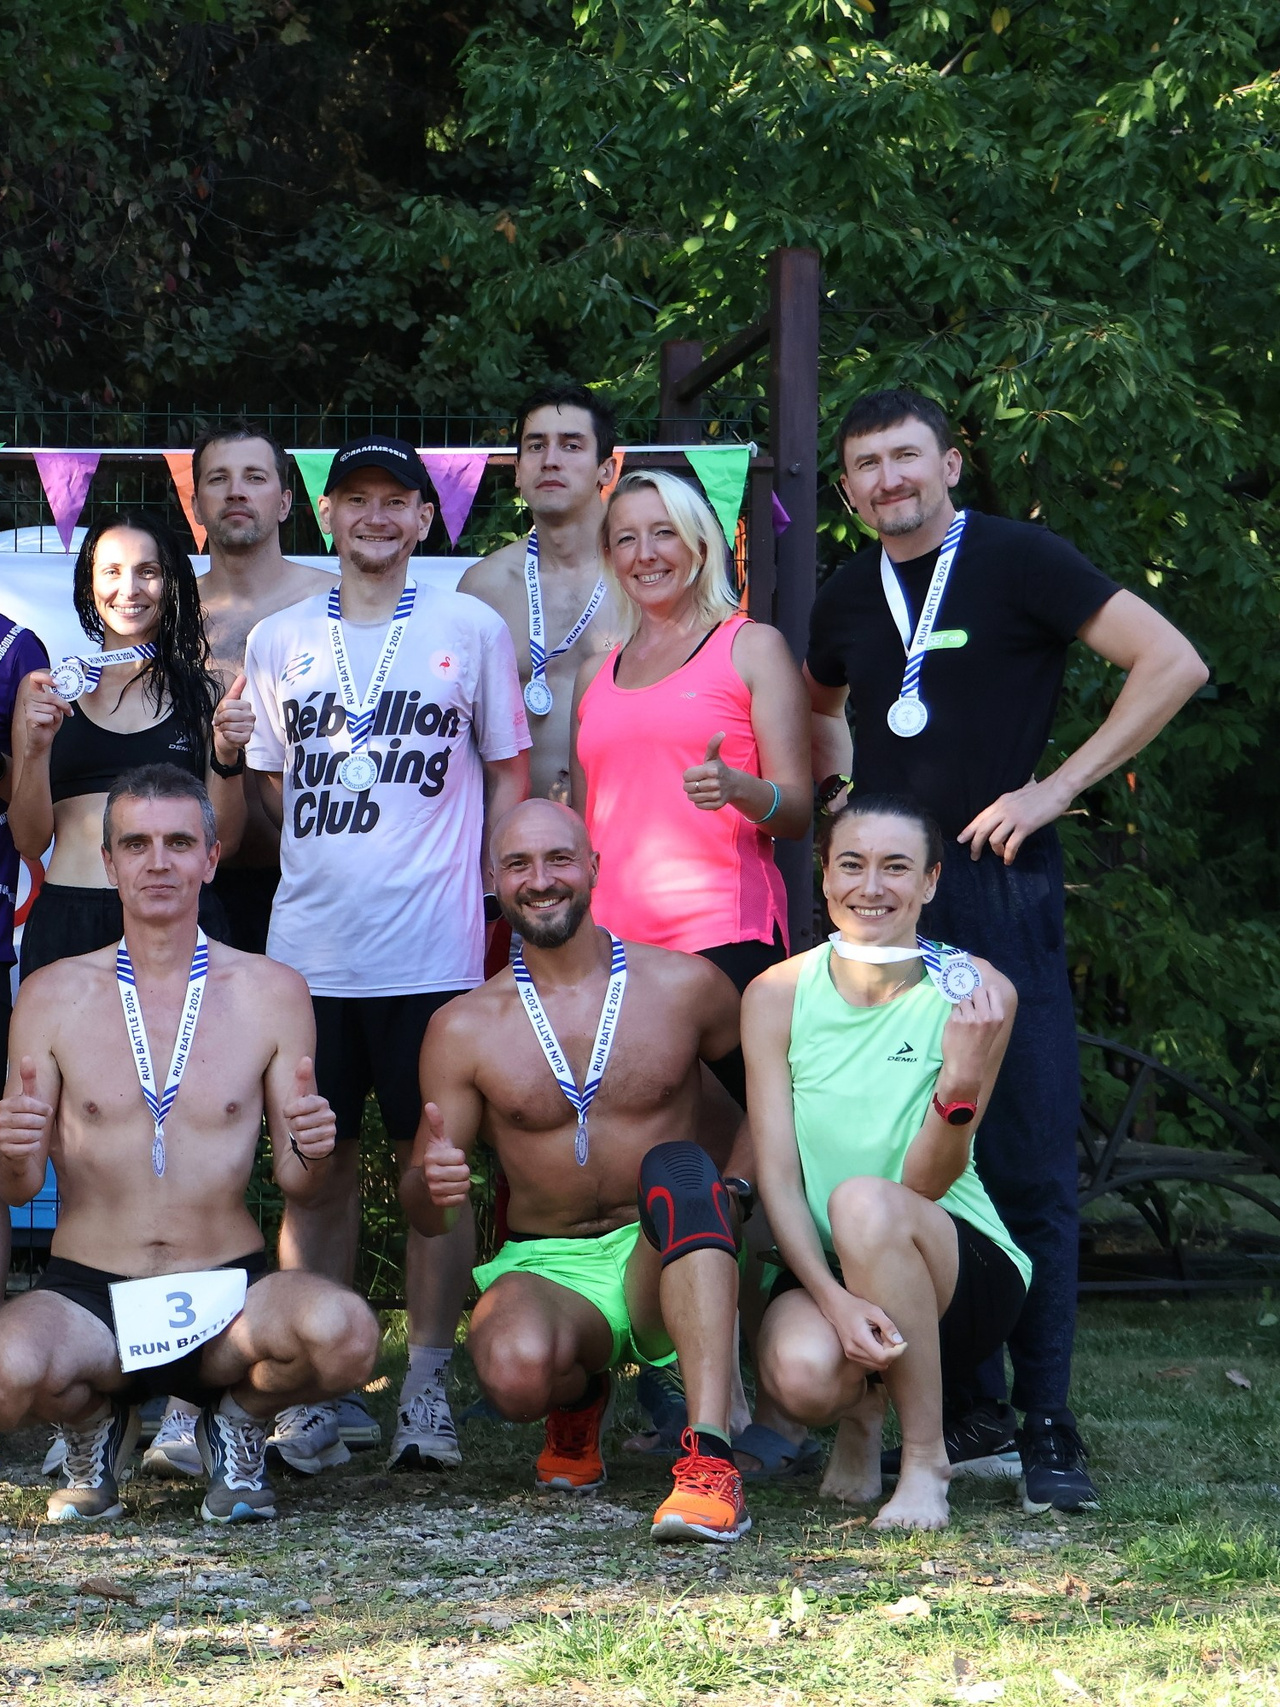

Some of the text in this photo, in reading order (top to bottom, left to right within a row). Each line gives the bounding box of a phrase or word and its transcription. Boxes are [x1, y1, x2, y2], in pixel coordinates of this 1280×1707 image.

[528, 560, 541, 636] RUN BATTLE 2024
[566, 625, 582, 645] RUN
[581, 593, 601, 627] BATTLE
[917, 559, 949, 645] RUN BATTLE 2024
[331, 625, 356, 705] RUN BATTLE 2024
[367, 625, 404, 705] RUN BATTLE 2024
[282, 689, 460, 746] Rébllion
[293, 789, 381, 839] Club
[124, 990, 150, 1081] RUN BATTLE 2024
[173, 987, 202, 1077] RUN BATTLE 2024
[523, 987, 566, 1074] RUN BATTLE 2024
[593, 981, 622, 1072] RUN BATTLE 2024
[128, 1340, 171, 1357] RUN
[165, 1291, 197, 1329] 3
